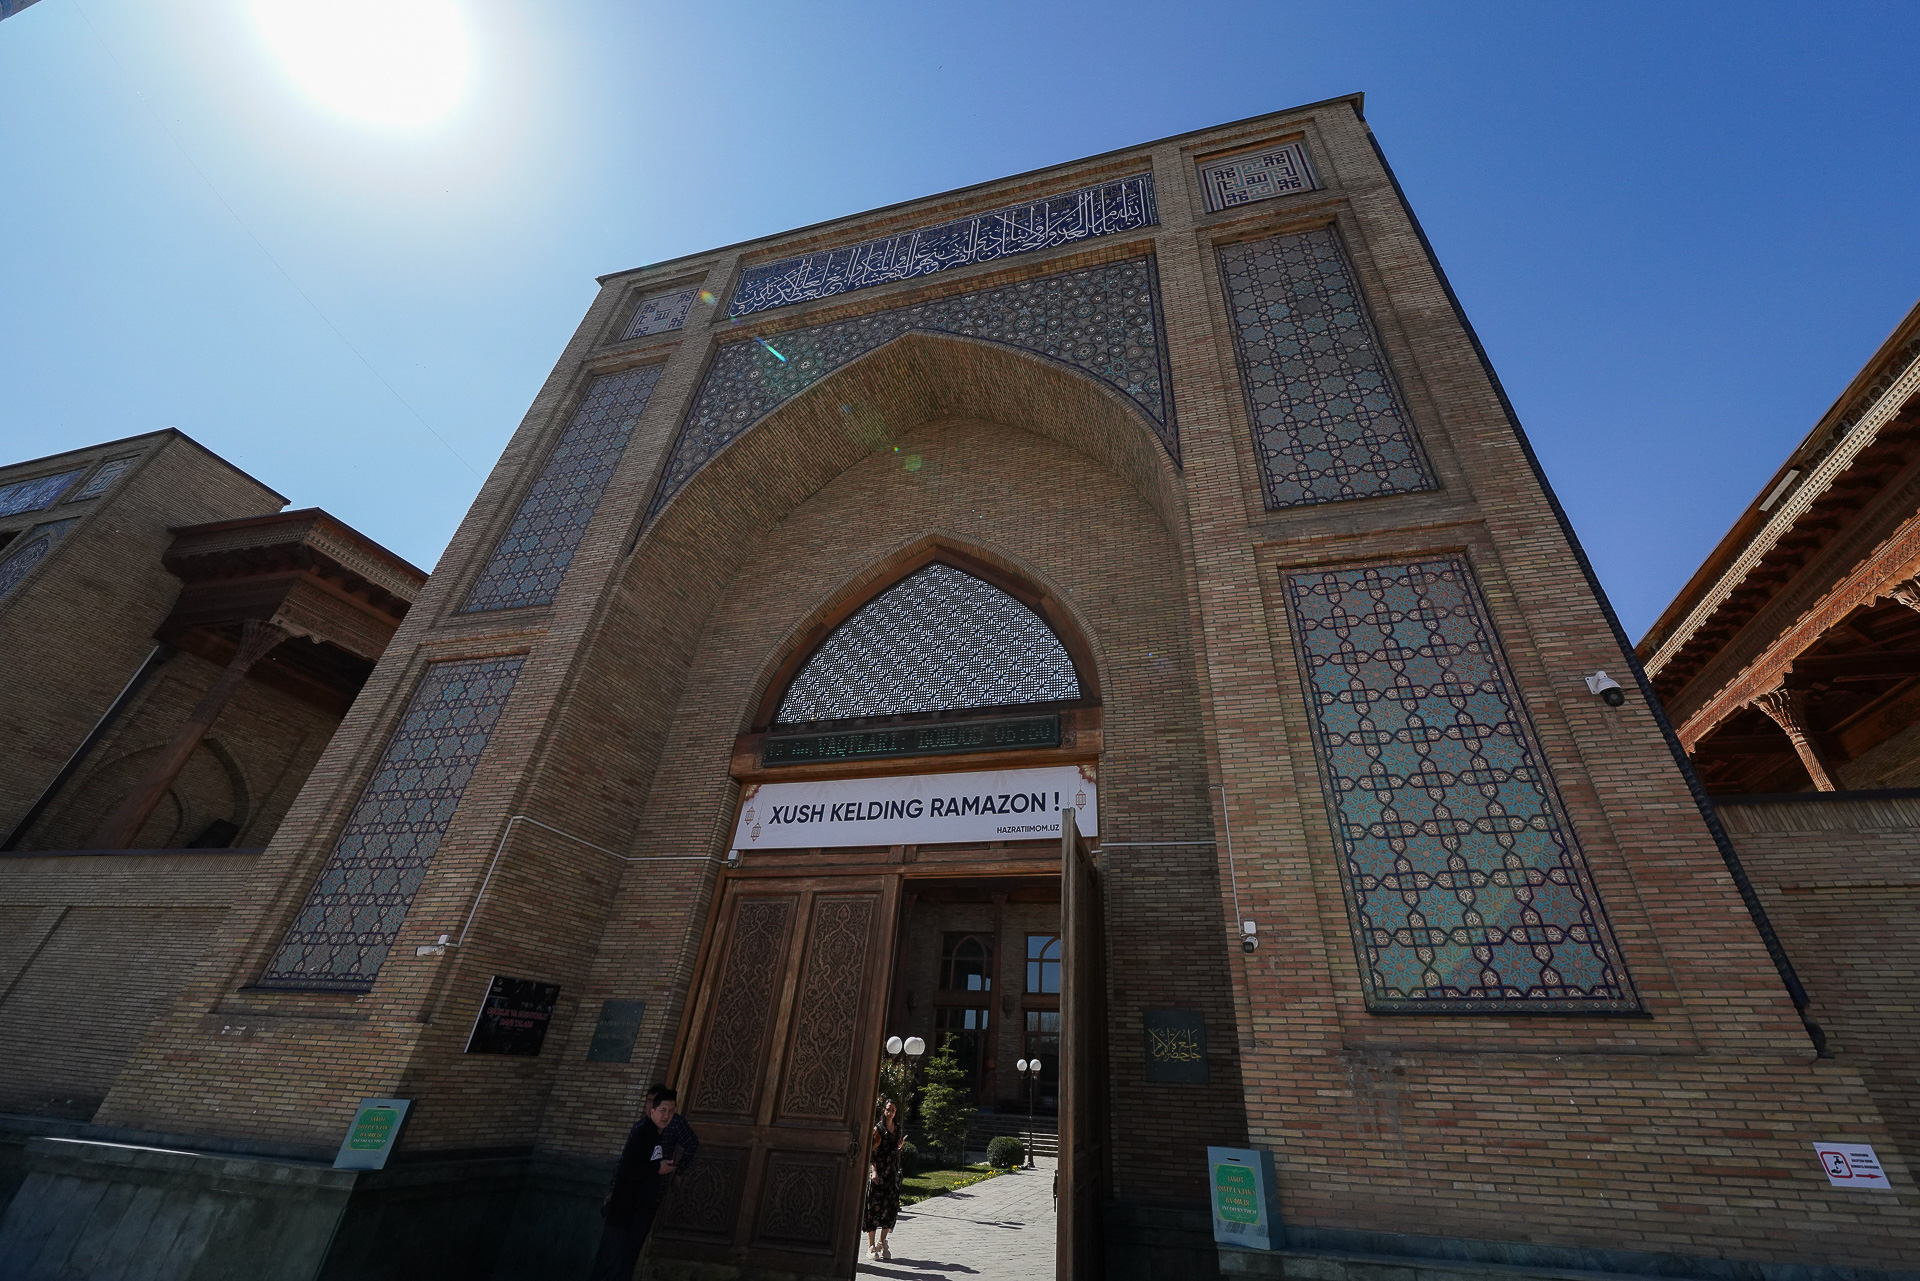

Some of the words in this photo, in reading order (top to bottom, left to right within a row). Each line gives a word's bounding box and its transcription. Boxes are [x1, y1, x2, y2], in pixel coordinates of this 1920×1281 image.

[769, 805, 824, 825] XUSH
[830, 798, 923, 822] KELDING
[930, 793, 1045, 818] RAMAZON
